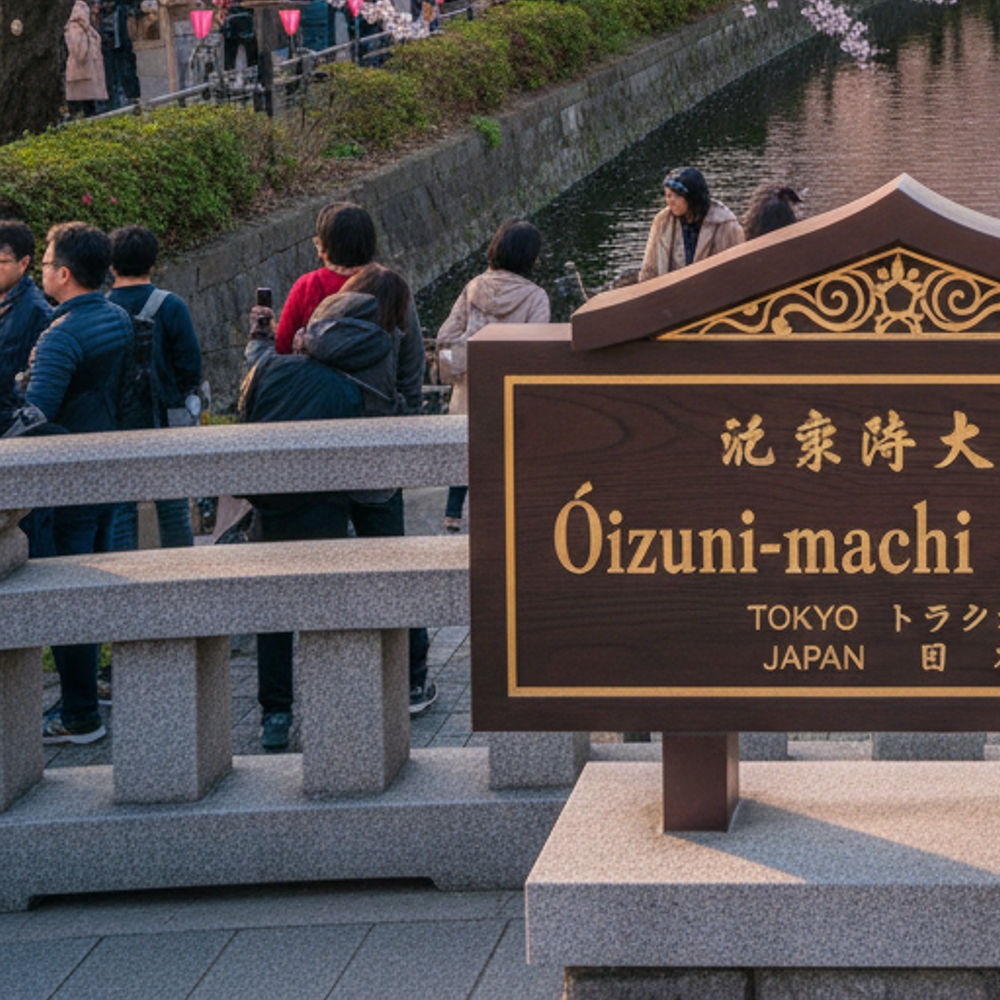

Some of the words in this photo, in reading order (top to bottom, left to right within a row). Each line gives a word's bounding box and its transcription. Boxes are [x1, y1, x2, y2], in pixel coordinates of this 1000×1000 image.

[553, 480, 974, 575] Óizuni-machi
[746, 604, 859, 631] TOKYO
[763, 644, 865, 671] JAPAN
